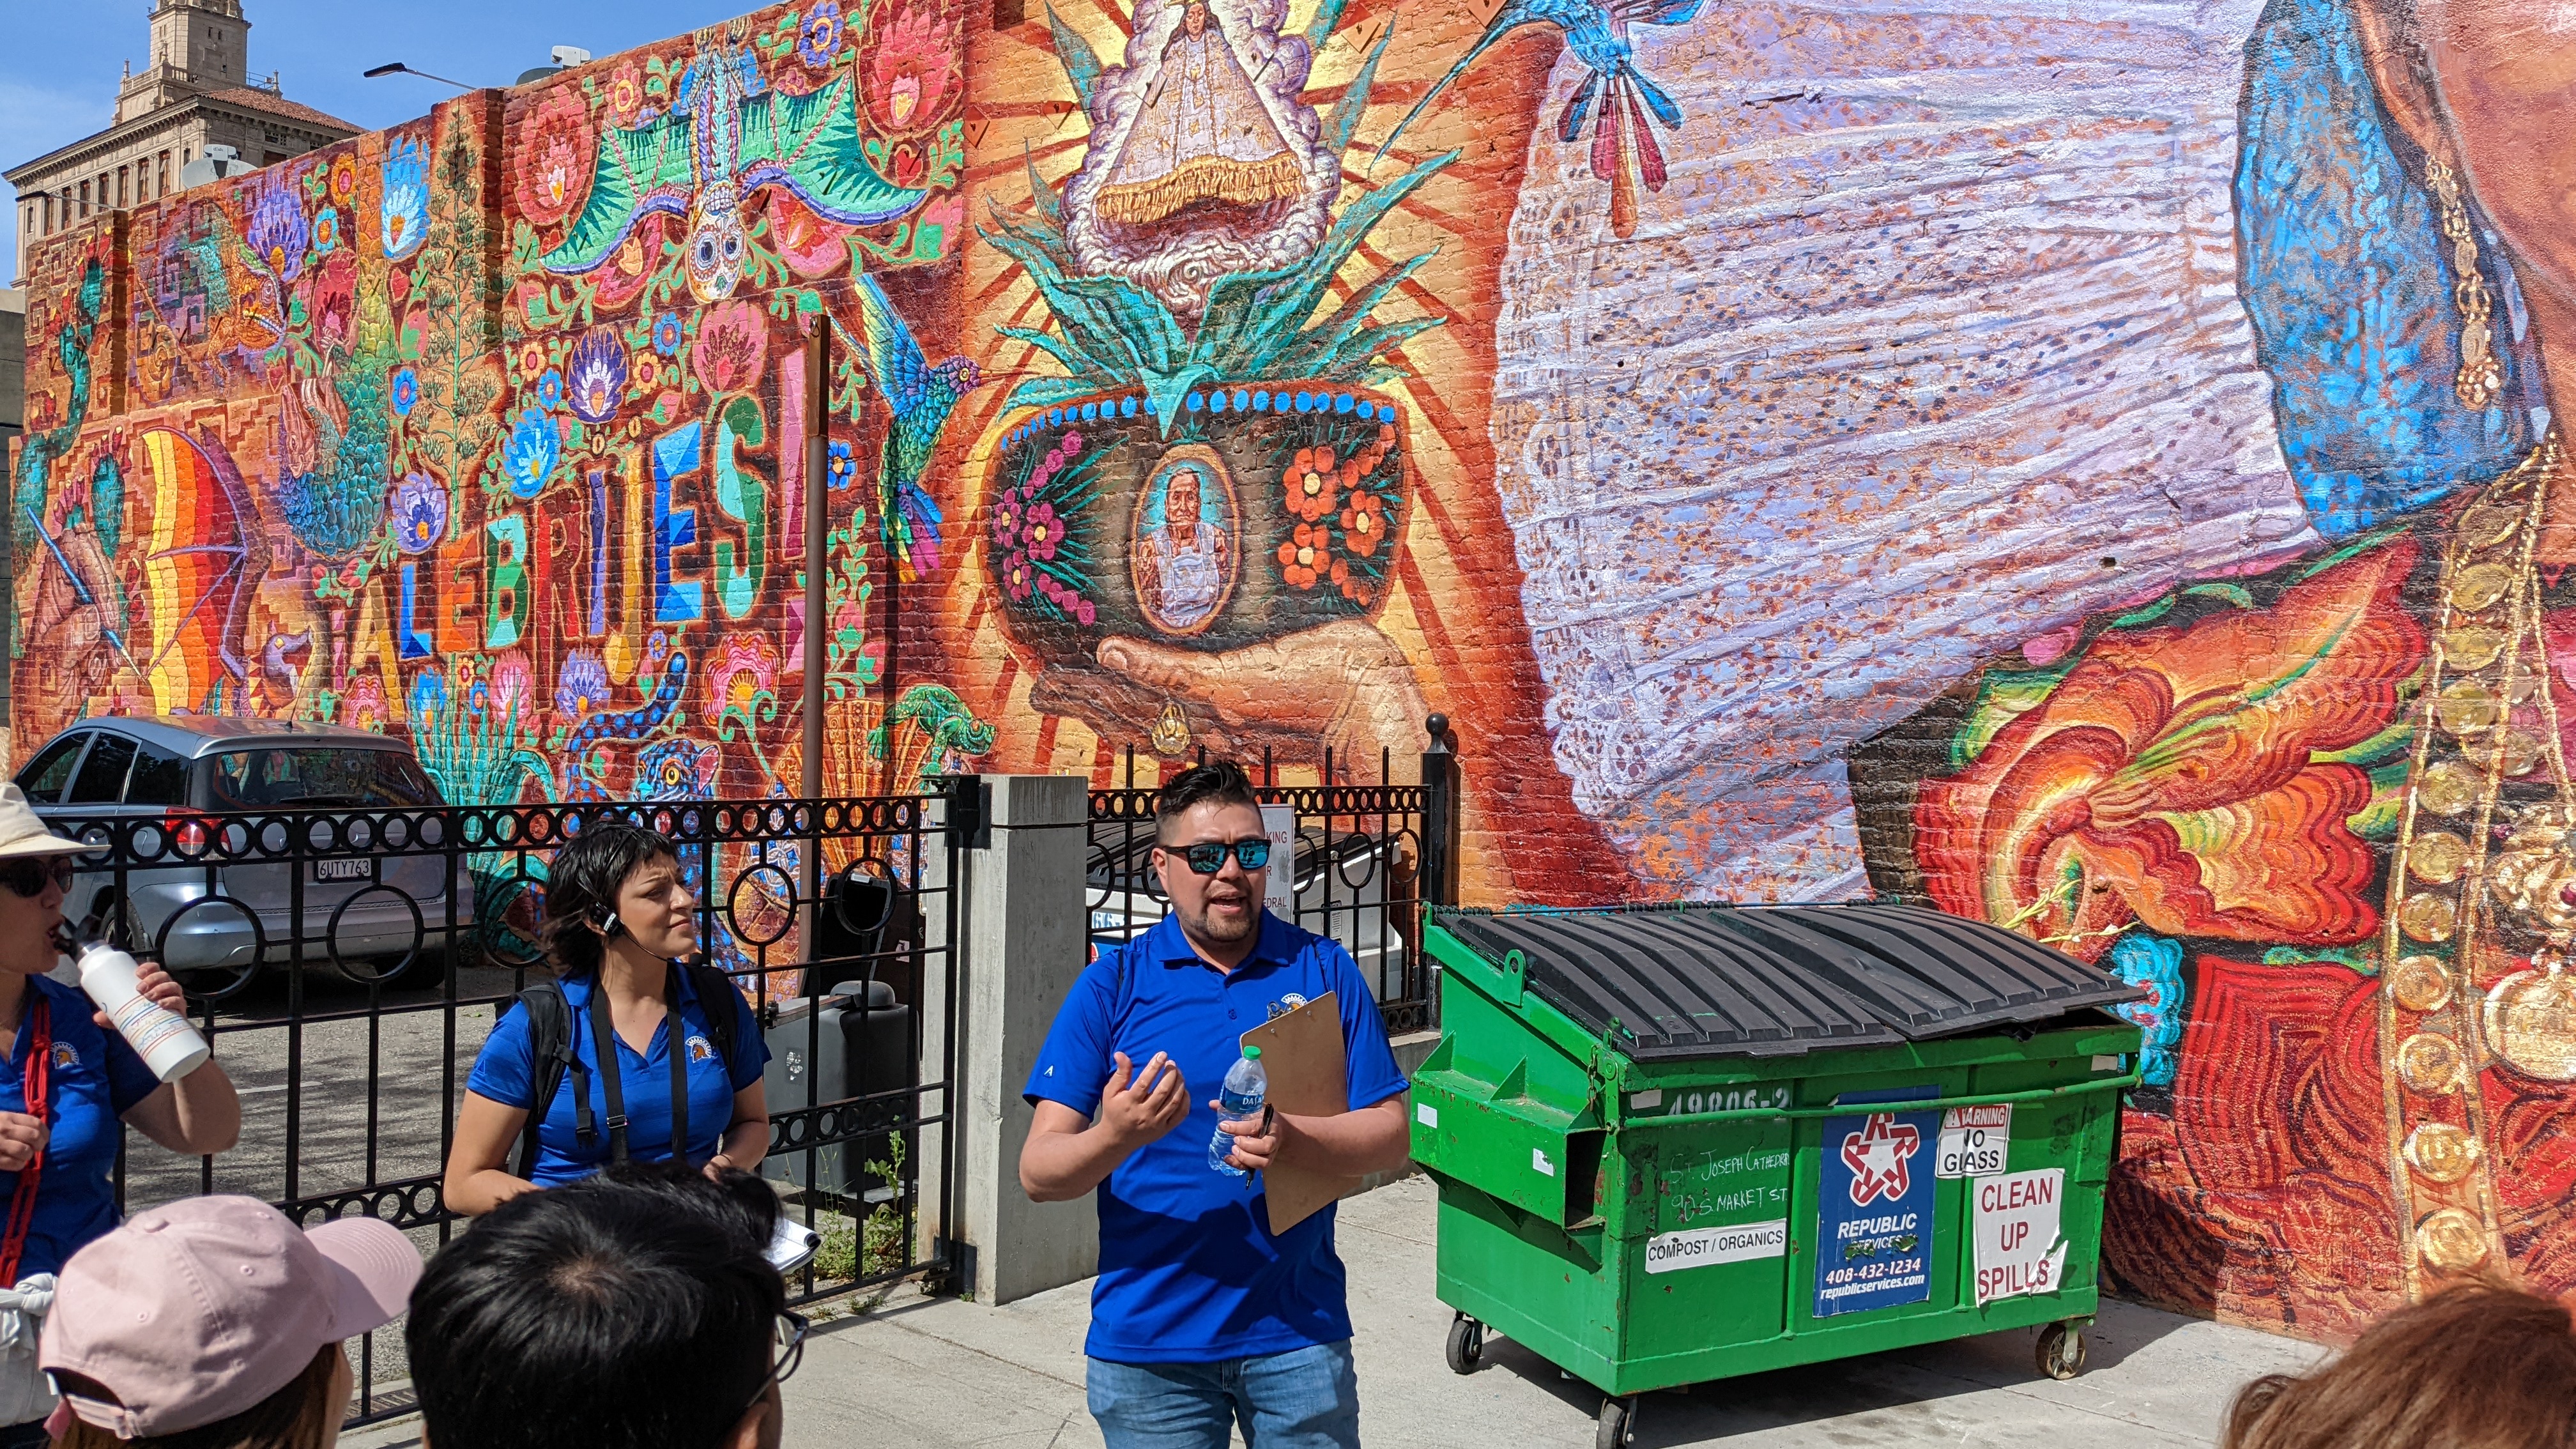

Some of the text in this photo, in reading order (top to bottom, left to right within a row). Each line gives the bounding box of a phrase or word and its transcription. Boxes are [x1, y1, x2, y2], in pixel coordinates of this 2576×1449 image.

[1266, 831, 1287, 844] KING
[319, 859, 369, 876] 6UTY763
[1263, 896, 1287, 908] DRAL
[1700, 1149, 1743, 1181] JOSEPH
[1944, 1149, 1999, 1172] GLASS
[1716, 1186, 1766, 1212] MARKET
[1981, 1176, 2053, 1213] CLEAN
[1837, 1213, 1917, 1239] REPUBLIC
[2000, 1221, 2029, 1252] UP
[1648, 1239, 1708, 1262] COMPOST
[1719, 1229, 1783, 1252] ORGANICS
[1825, 1257, 1922, 1285] 408-432-1234
[1978, 1259, 2050, 1298] SPILLS
[1820, 1274, 1925, 1300] republicservices.com
